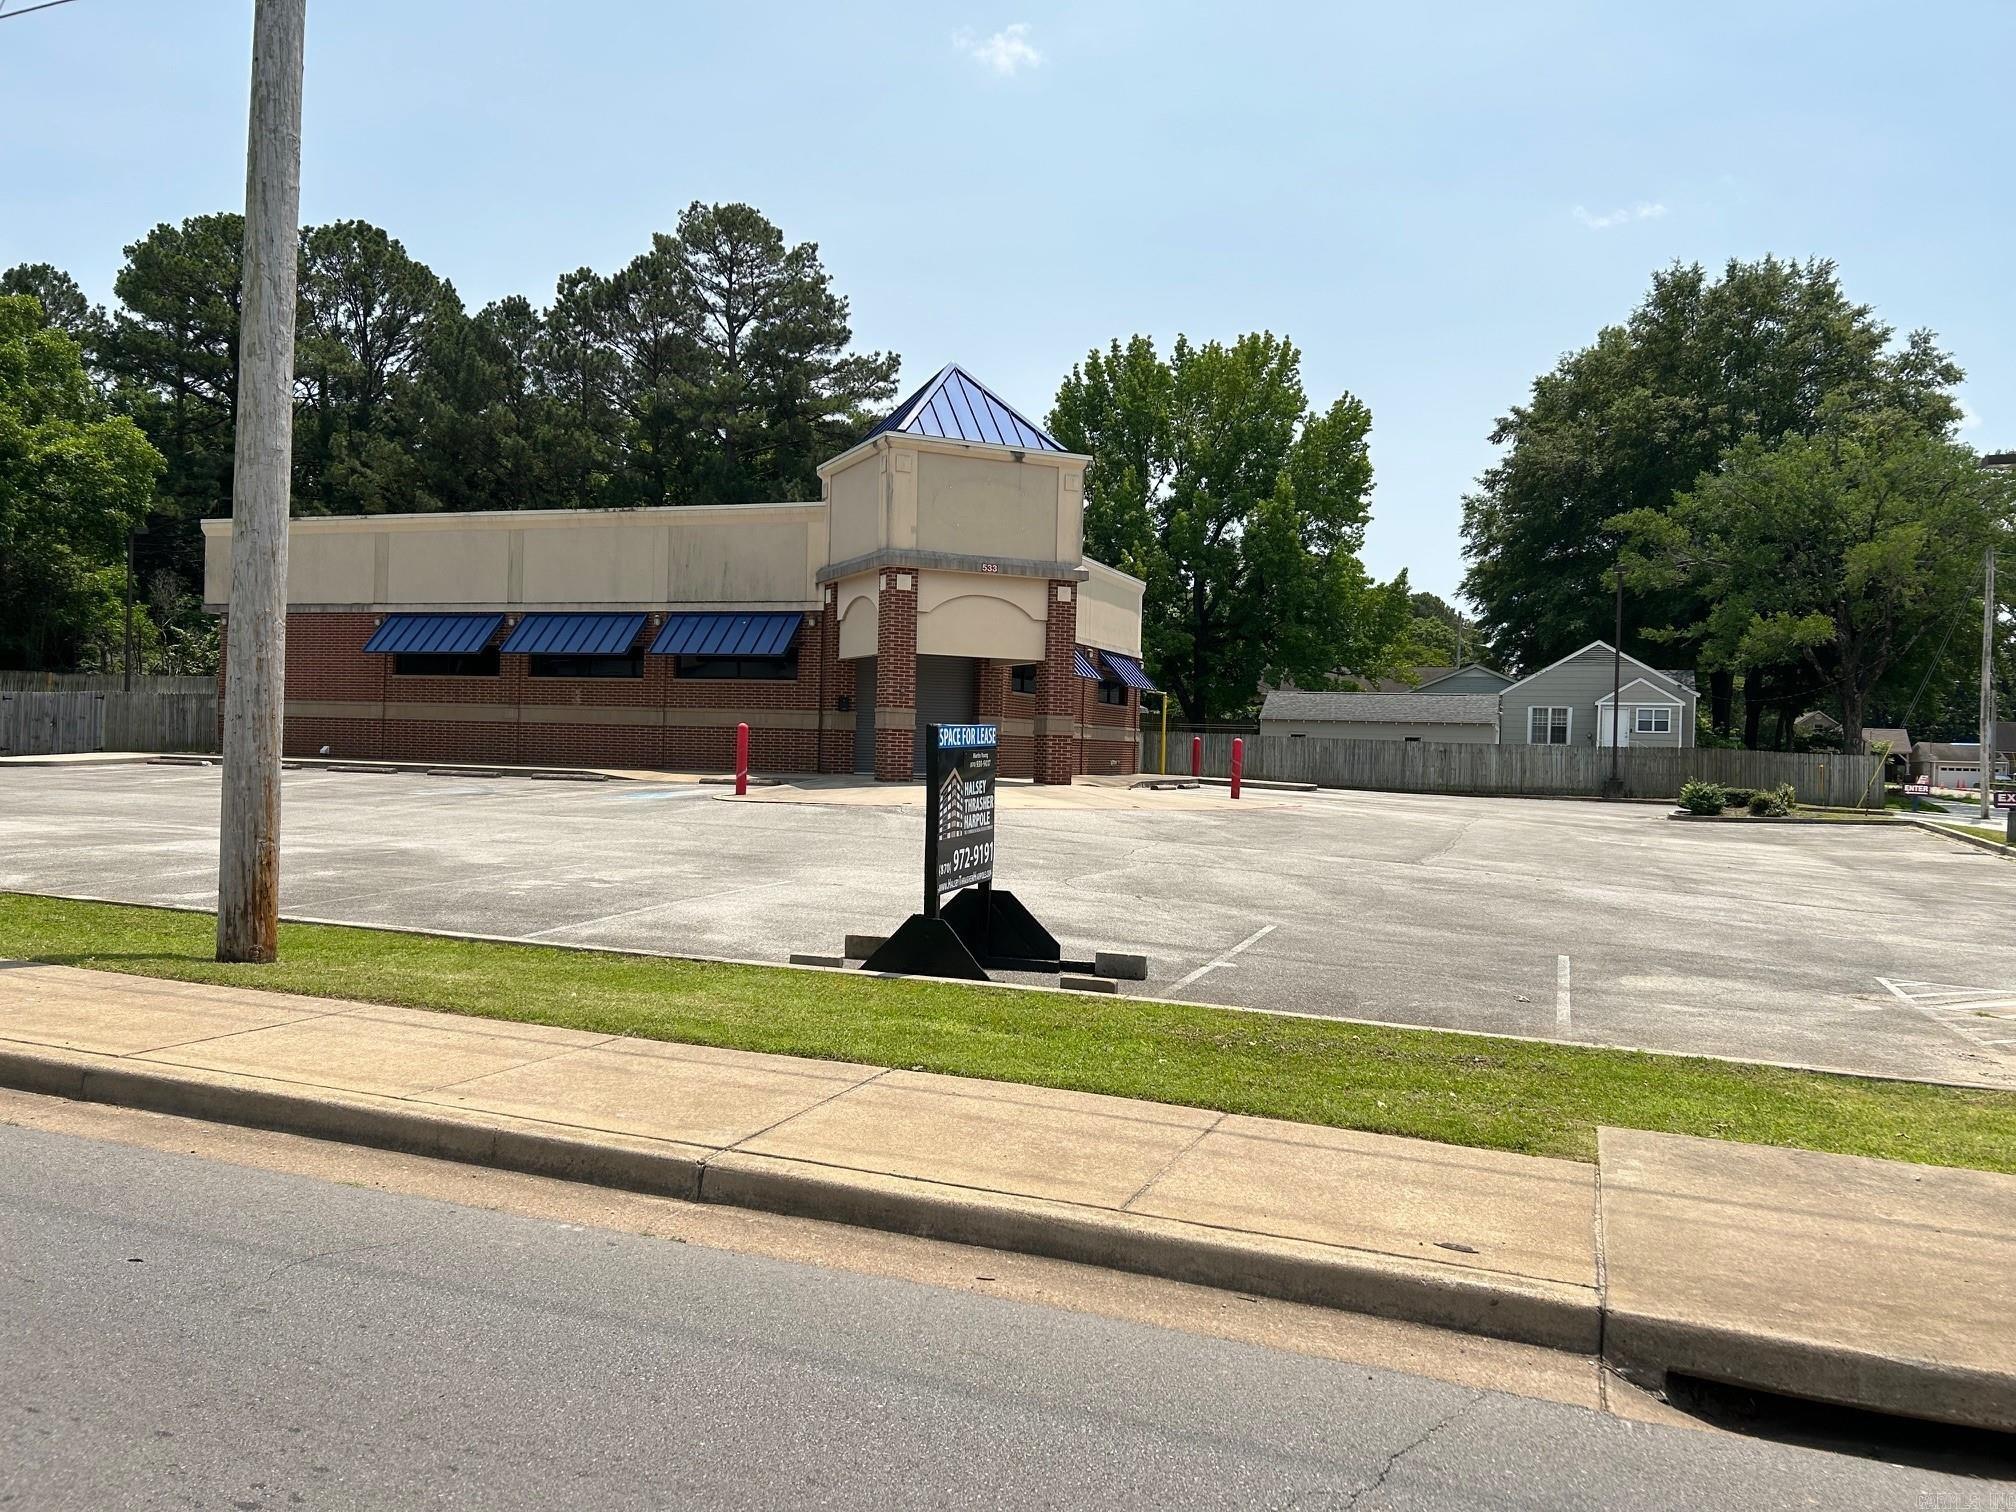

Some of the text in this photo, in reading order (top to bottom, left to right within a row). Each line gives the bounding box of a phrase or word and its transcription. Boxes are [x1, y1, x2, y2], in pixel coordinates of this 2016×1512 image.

[983, 564, 997, 572] 533
[939, 727, 996, 746] SPACE FOR LEASE
[964, 779, 987, 796] HALSEY
[964, 795, 993, 813] THRASHER
[964, 811, 991, 830] HARPOLE
[953, 841, 993, 872] 972-9191
